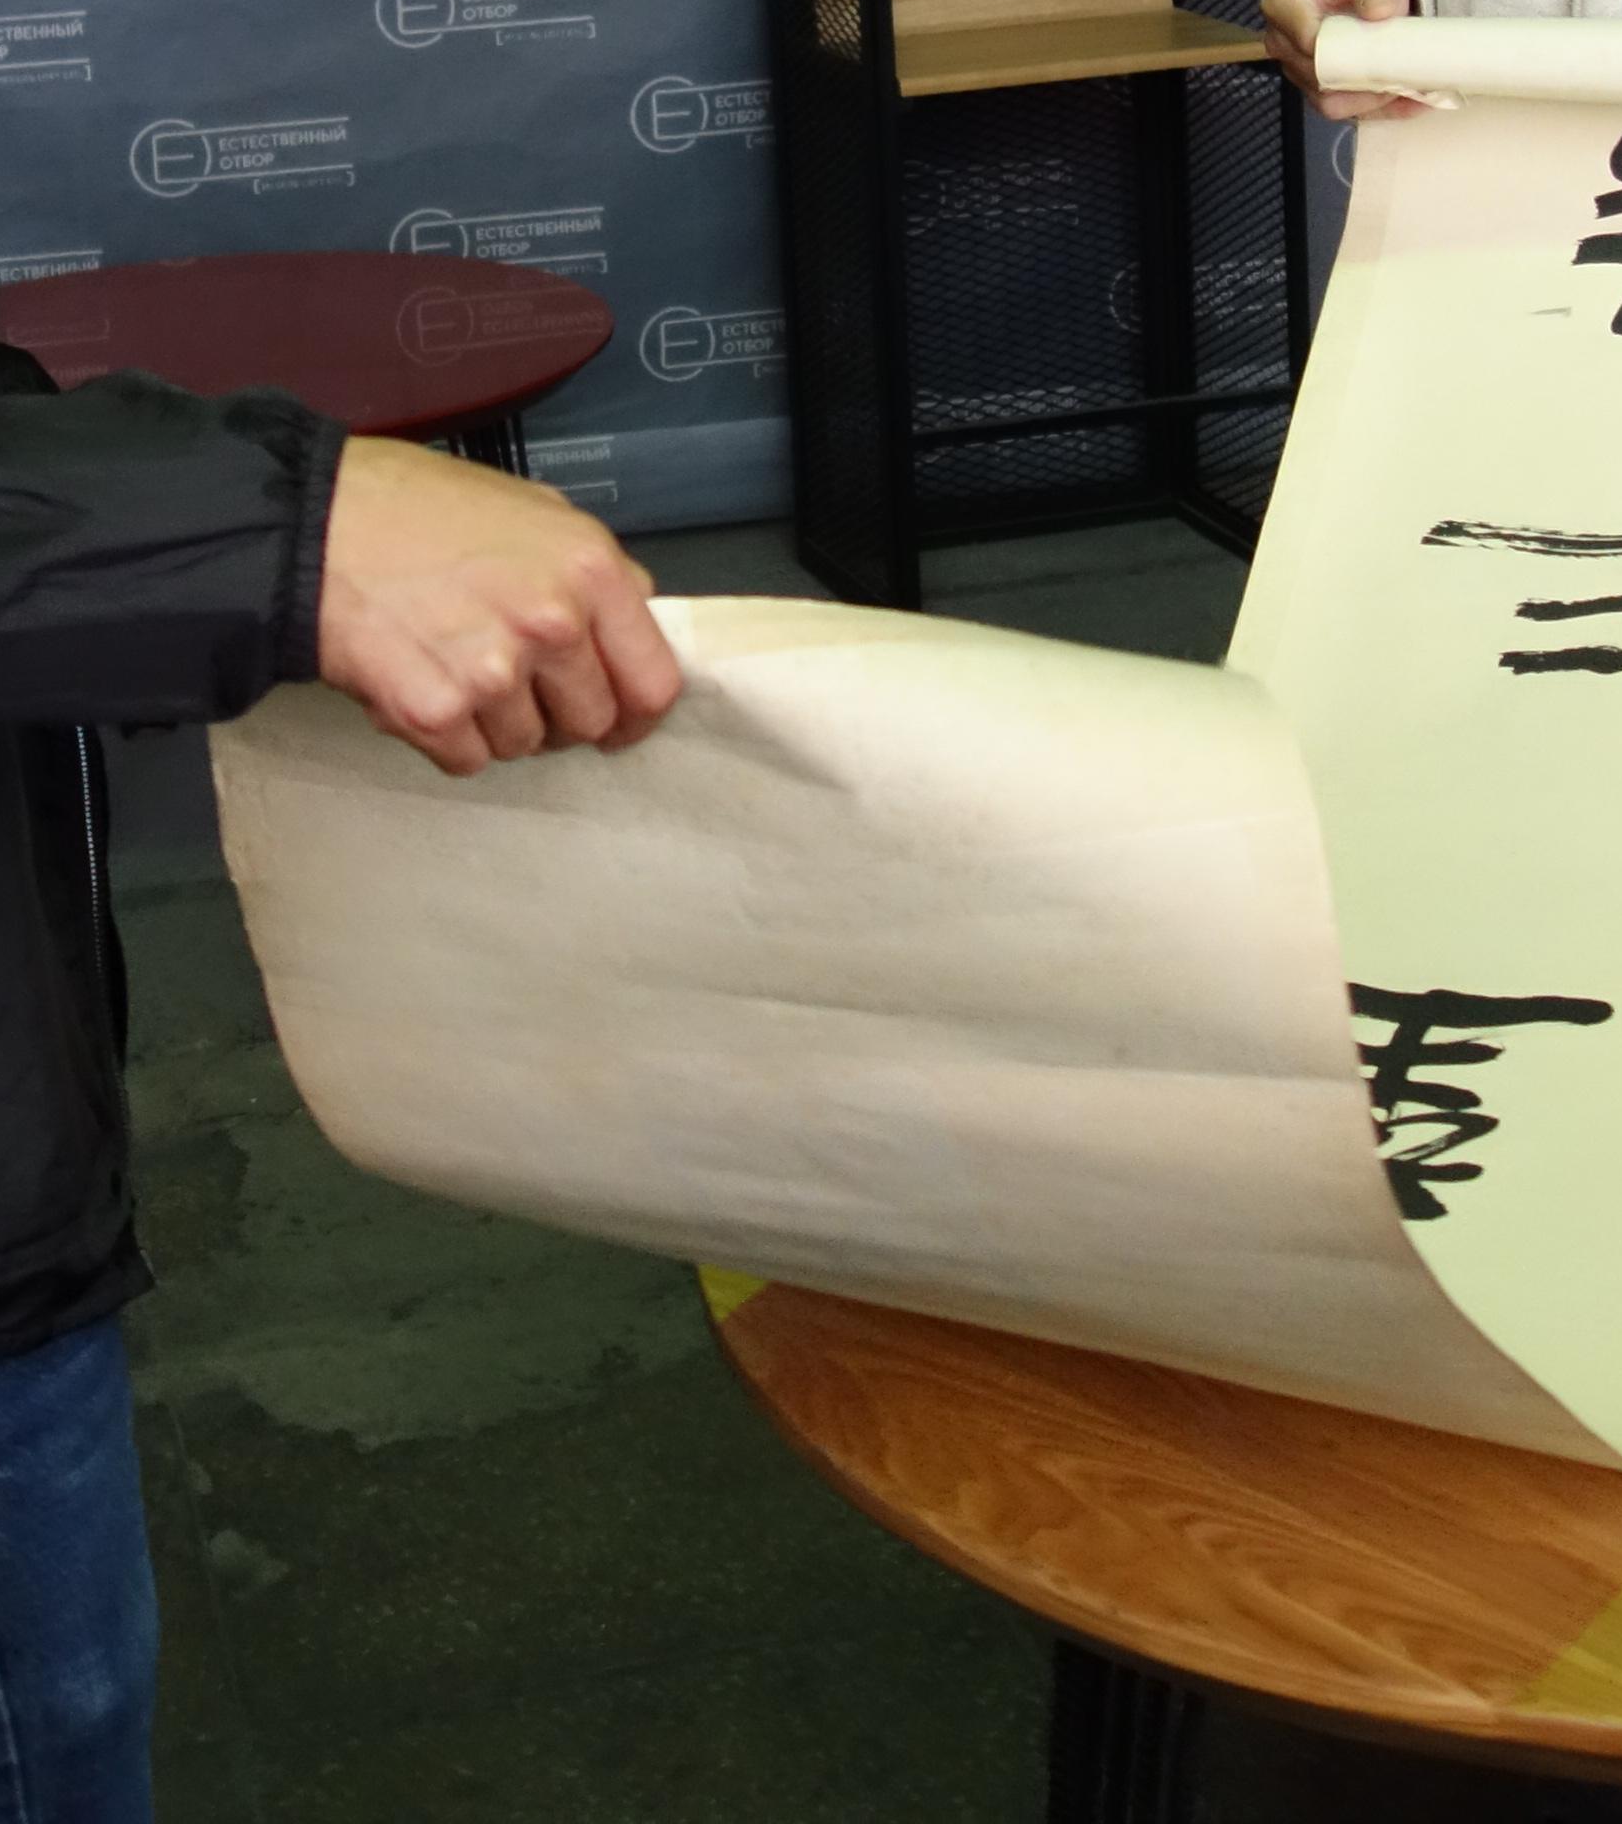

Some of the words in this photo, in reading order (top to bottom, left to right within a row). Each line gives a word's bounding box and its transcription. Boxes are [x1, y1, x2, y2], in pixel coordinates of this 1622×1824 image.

[463, 4, 518, 21] ОТБОР
[716, 109, 768, 126] ОТБОР
[219, 124, 346, 153] ЕСТЕСТВЕННЫЙ
[220, 153, 276, 170] ОТБОР
[476, 214, 600, 242] ЕСТЕСТВЕННЫЙ
[477, 242, 532, 259] ОТБОР
[723, 337, 776, 355] ОТБОР
